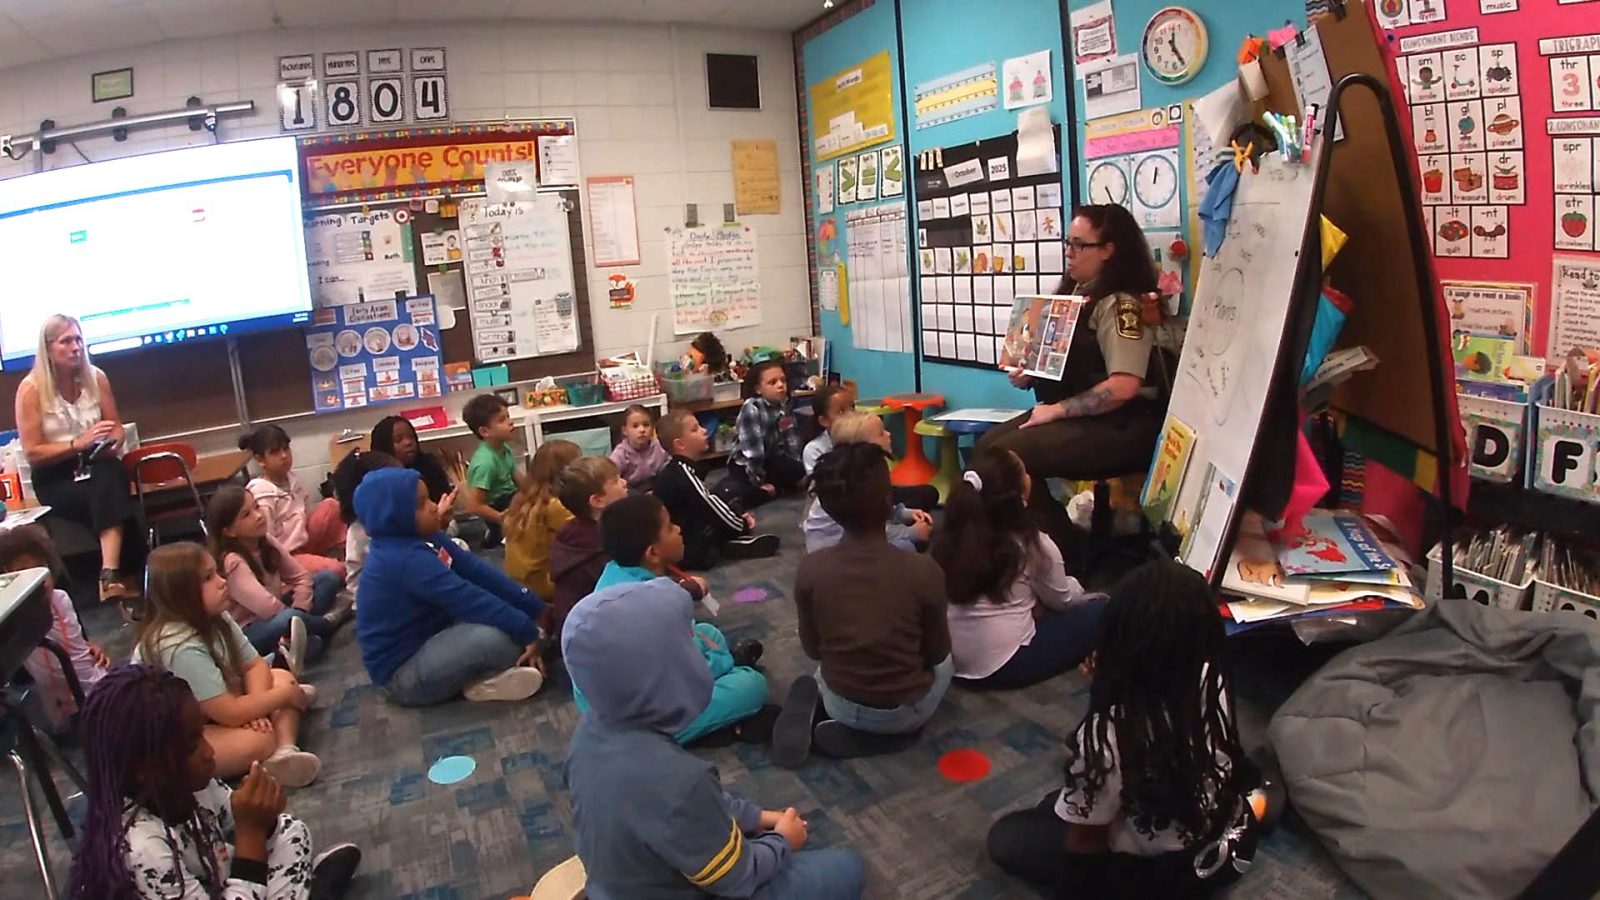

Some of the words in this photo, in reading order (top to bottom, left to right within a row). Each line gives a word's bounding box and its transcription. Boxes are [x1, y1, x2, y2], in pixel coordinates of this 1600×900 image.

[1486, 2, 1511, 10] music
[1155, 37, 1163, 45] 10
[1455, 54, 1466, 62] sc
[1491, 49, 1503, 59] sp
[1418, 57, 1432, 65] sm
[1560, 59, 1578, 70] thr
[1488, 86, 1511, 95] spider
[1562, 73, 1580, 97] 3
[1449, 88, 1477, 98] scooter
[293, 89, 305, 125] 1
[332, 86, 355, 121] 8
[374, 83, 398, 118] 0
[422, 81, 440, 113] 4
[1497, 98, 1507, 112] pl
[1561, 100, 1584, 108] three
[1461, 103, 1470, 116] gl
[1556, 119, 1600, 132] CONSONAN
[1492, 139, 1516, 149] planet
[1563, 143, 1582, 154] spr
[309, 149, 433, 177] Everyone
[443, 141, 533, 167] Counts!
[1427, 156, 1438, 167] fr
[1464, 155, 1474, 165] tr
[1498, 153, 1511, 164] dr
[954, 167, 976, 178] October
[991, 163, 1007, 174] 2025
[1556, 181, 1591, 191] sprinkles
[1454, 194, 1487, 202] treasure
[1496, 192, 1516, 200] drum
[1565, 197, 1583, 207] str
[484, 206, 512, 218] Today
[515, 207, 524, 215] is
[350, 211, 390, 225] Targets
[690, 232, 710, 240] Daily
[1562, 265, 1586, 280] Read
[1472, 424, 1509, 468] D
[1551, 440, 1583, 484] F
